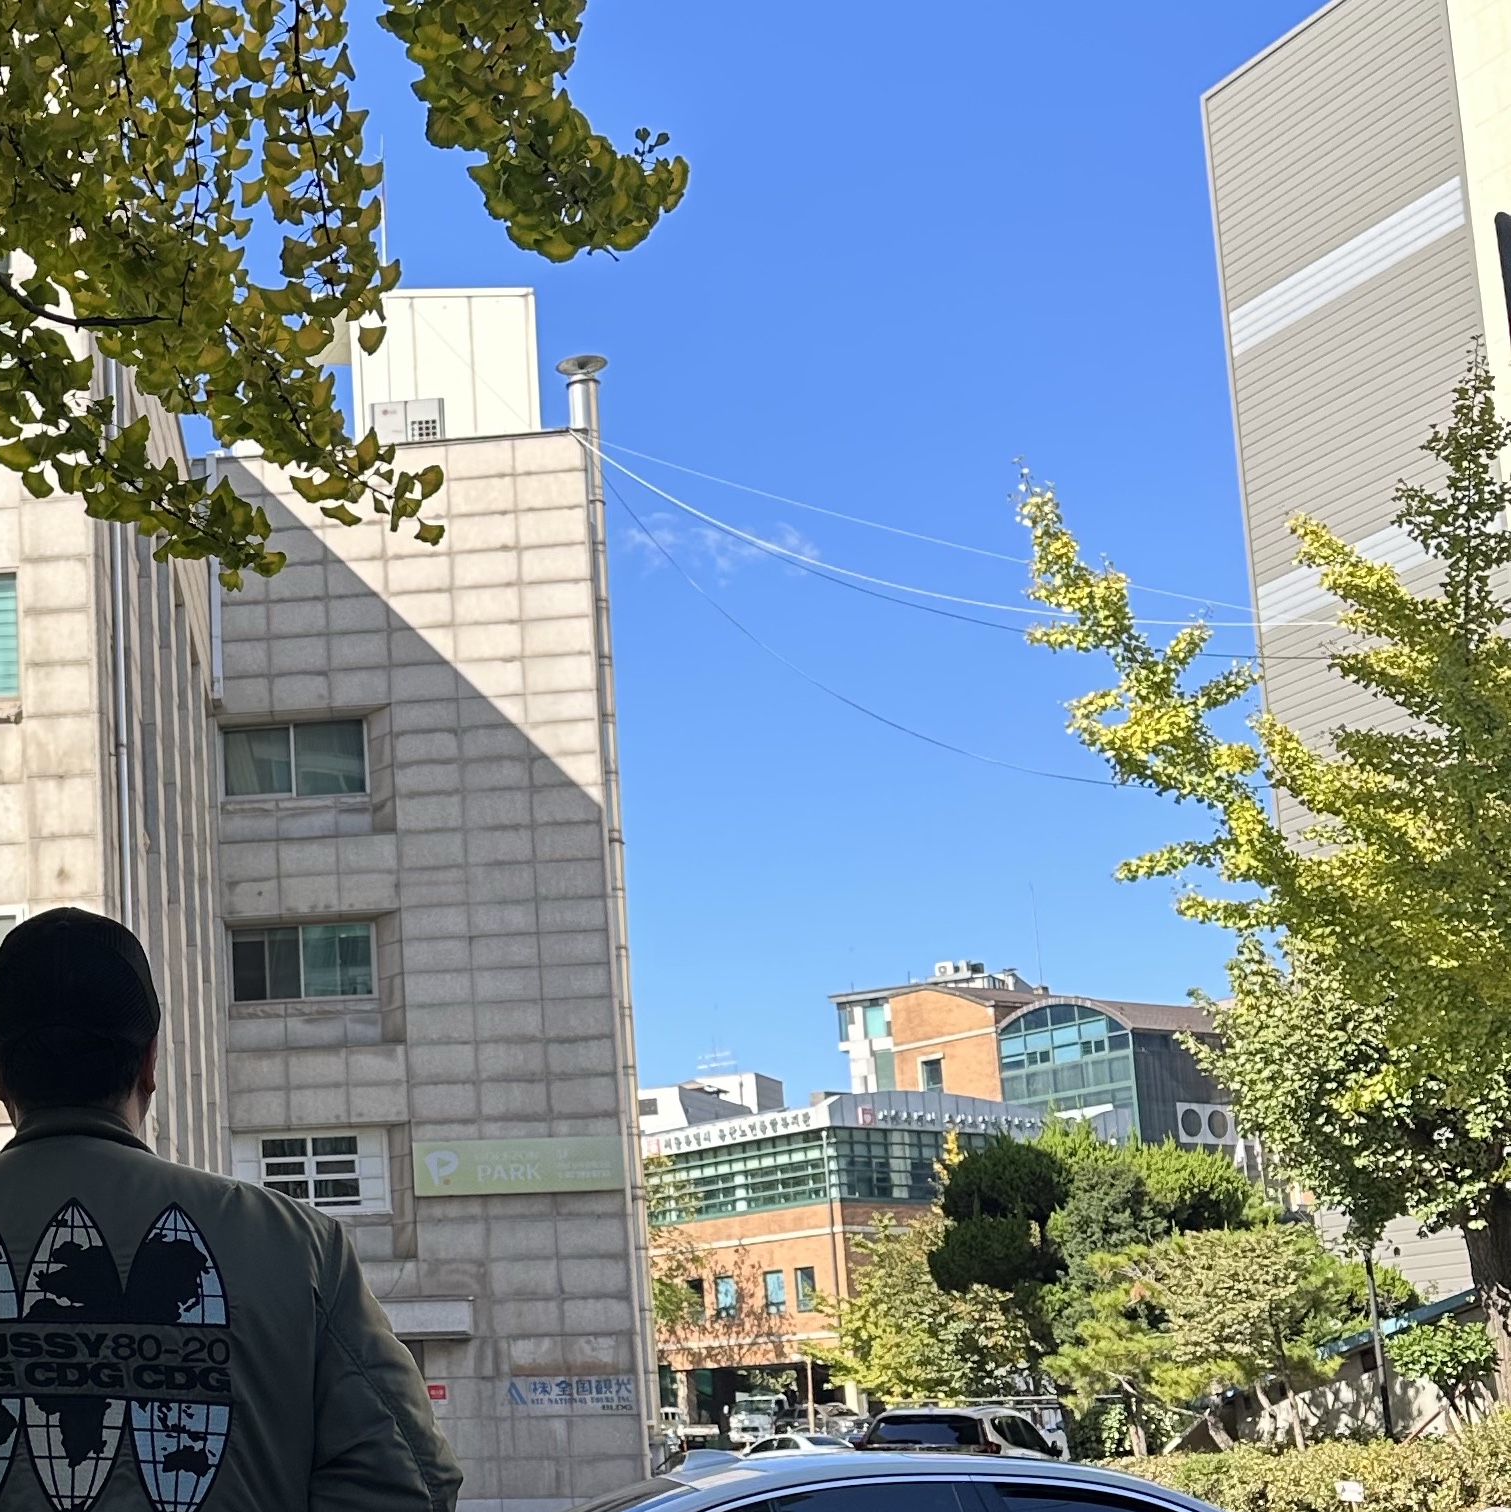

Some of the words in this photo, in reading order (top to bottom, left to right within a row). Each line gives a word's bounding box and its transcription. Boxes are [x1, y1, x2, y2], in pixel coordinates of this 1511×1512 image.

[476, 1163, 541, 1181] PARK
[24, 1361, 125, 1389] CDG
[133, 1363, 232, 1393] CDG
